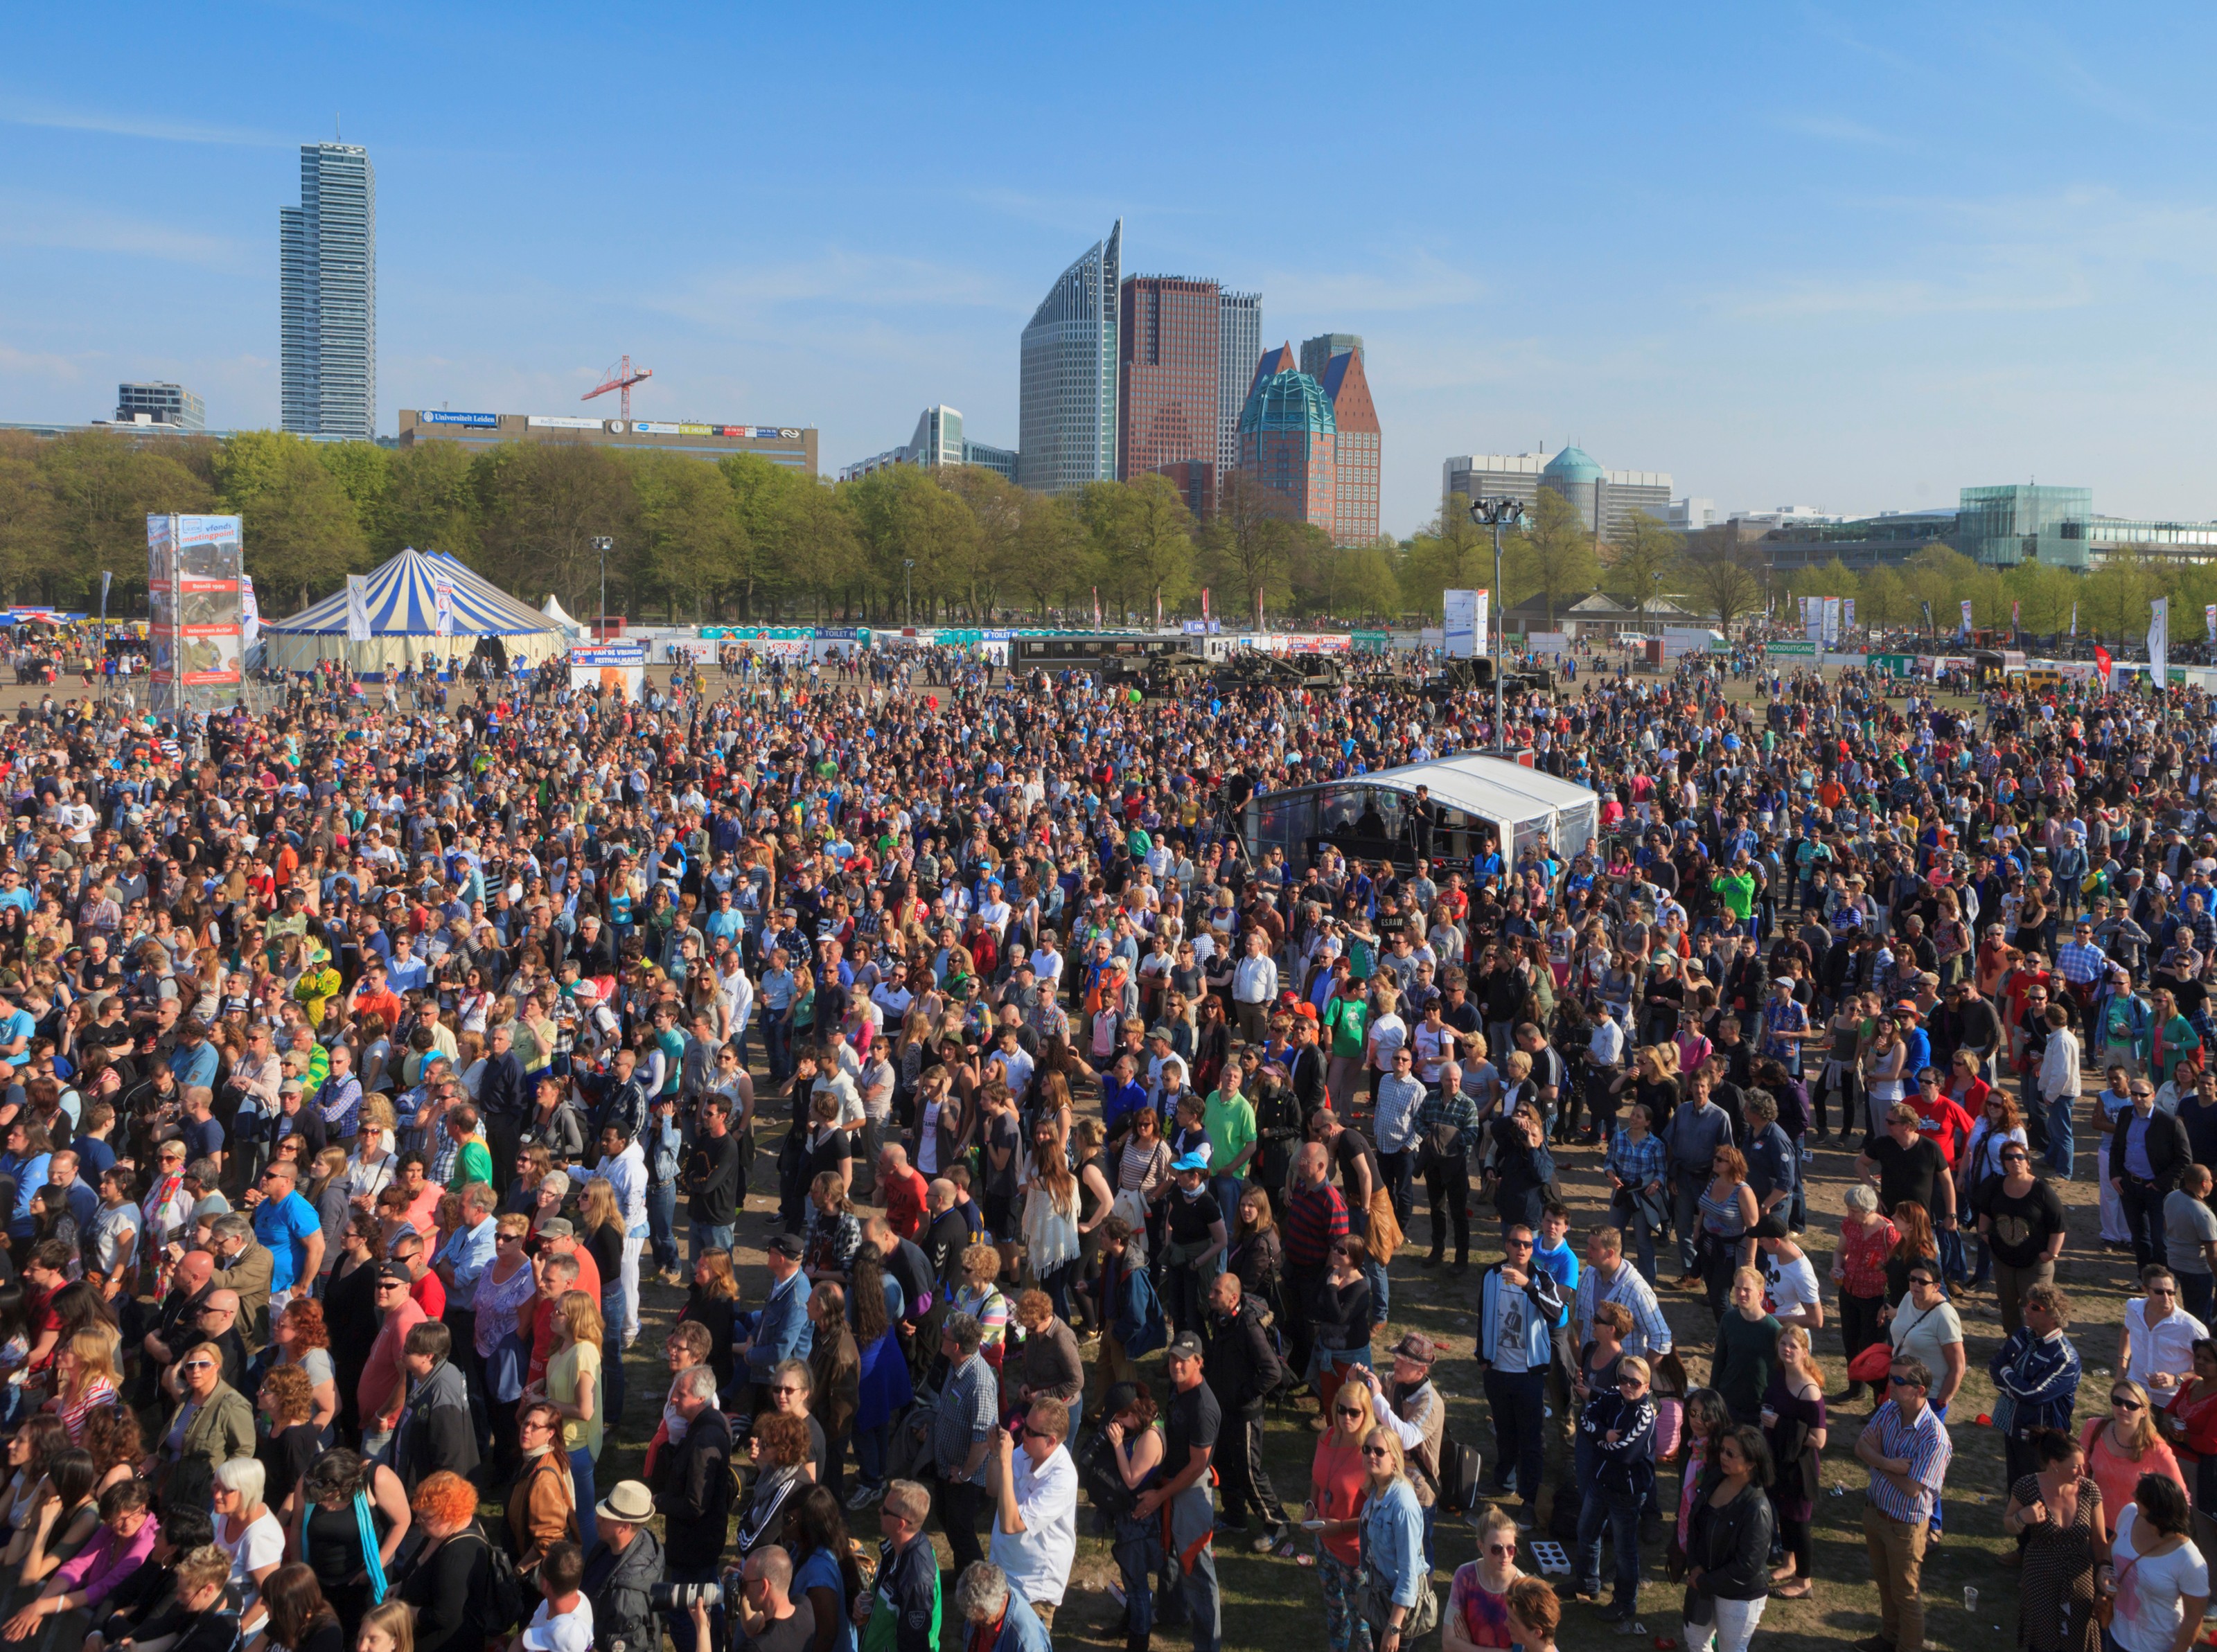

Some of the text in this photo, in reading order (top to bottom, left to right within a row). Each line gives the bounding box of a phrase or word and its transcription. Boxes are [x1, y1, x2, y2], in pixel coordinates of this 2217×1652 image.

[434, 414, 472, 422] Universiteit
[206, 523, 232, 532] vfonds
[182, 529, 234, 542] meetingpoint
